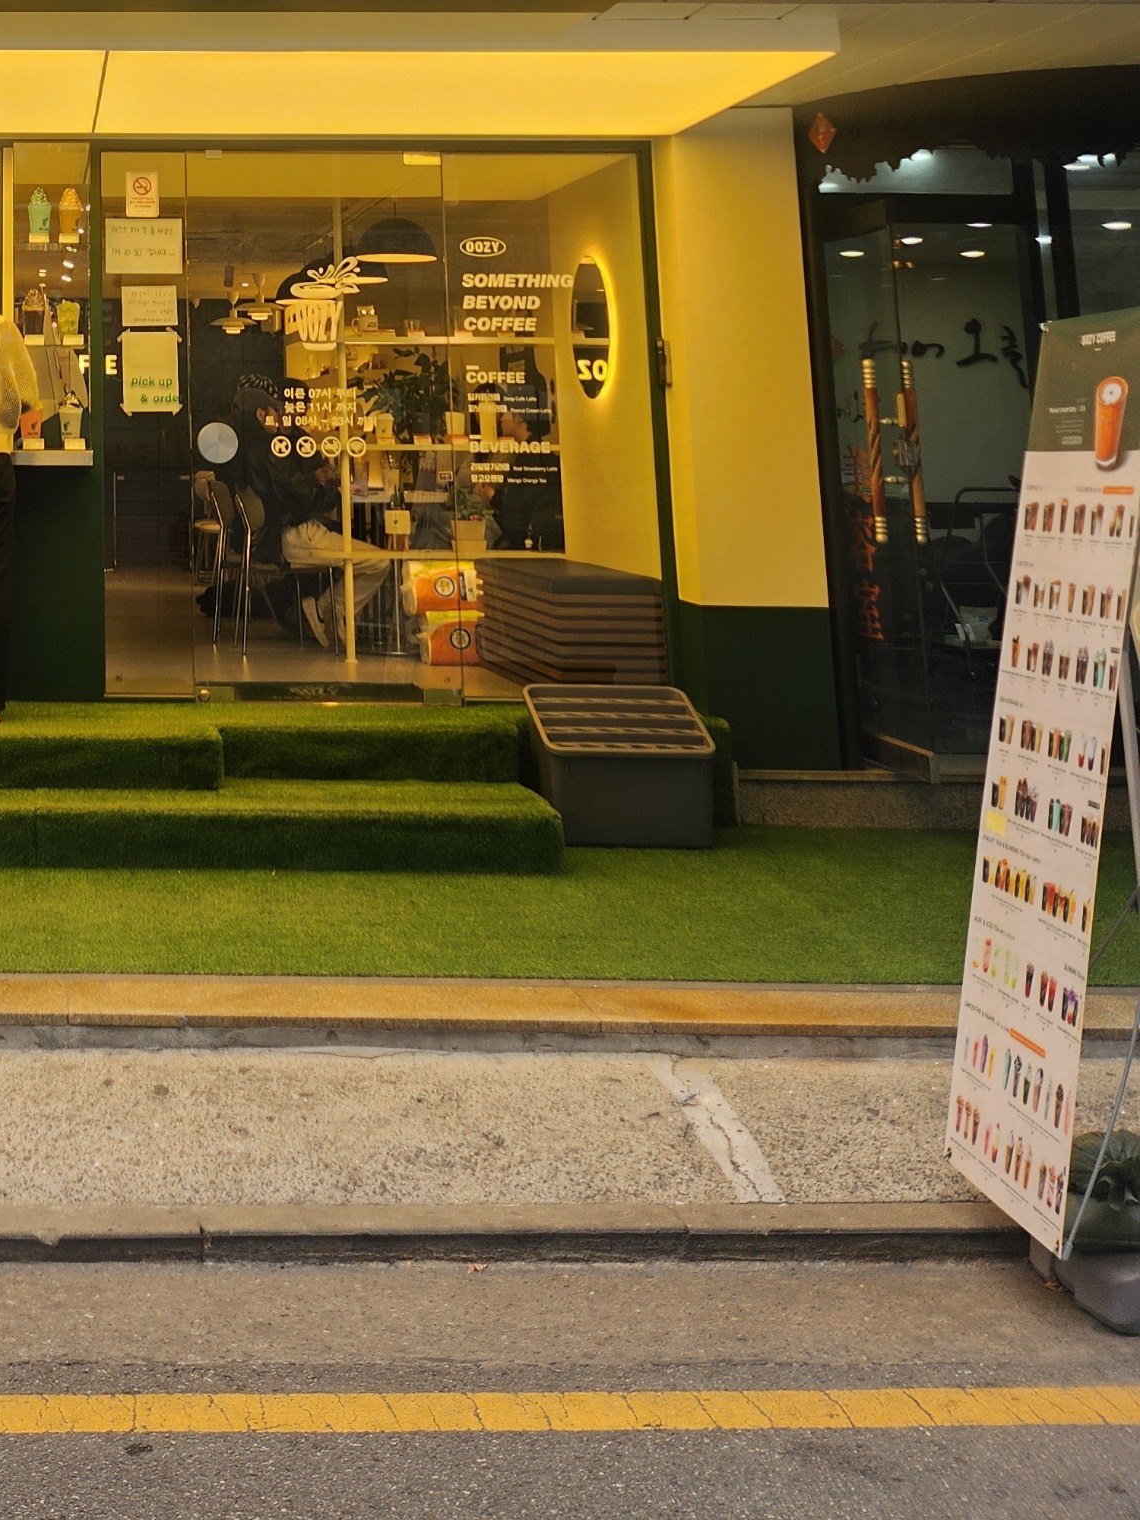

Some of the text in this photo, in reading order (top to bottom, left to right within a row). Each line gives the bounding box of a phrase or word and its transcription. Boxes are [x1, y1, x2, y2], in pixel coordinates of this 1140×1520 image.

[465, 240, 500, 254] OOZY
[461, 273, 575, 289] SOMETHING
[462, 295, 541, 310] BEYOND
[296, 298, 344, 343] OOZY
[463, 316, 538, 332] COFFEE
[131, 375, 173, 388] pick up
[465, 371, 526, 384] COFFEE
[140, 393, 149, 403] &
[284, 387, 306, 399] 이른
[308, 388, 332, 399] 07시
[284, 401, 357, 414] 늦은 11시 까지
[282, 415, 292, 428] 일
[295, 416, 317, 427] 08시
[331, 416, 355, 427] 23시
[469, 441, 551, 454] BEVERAGE
